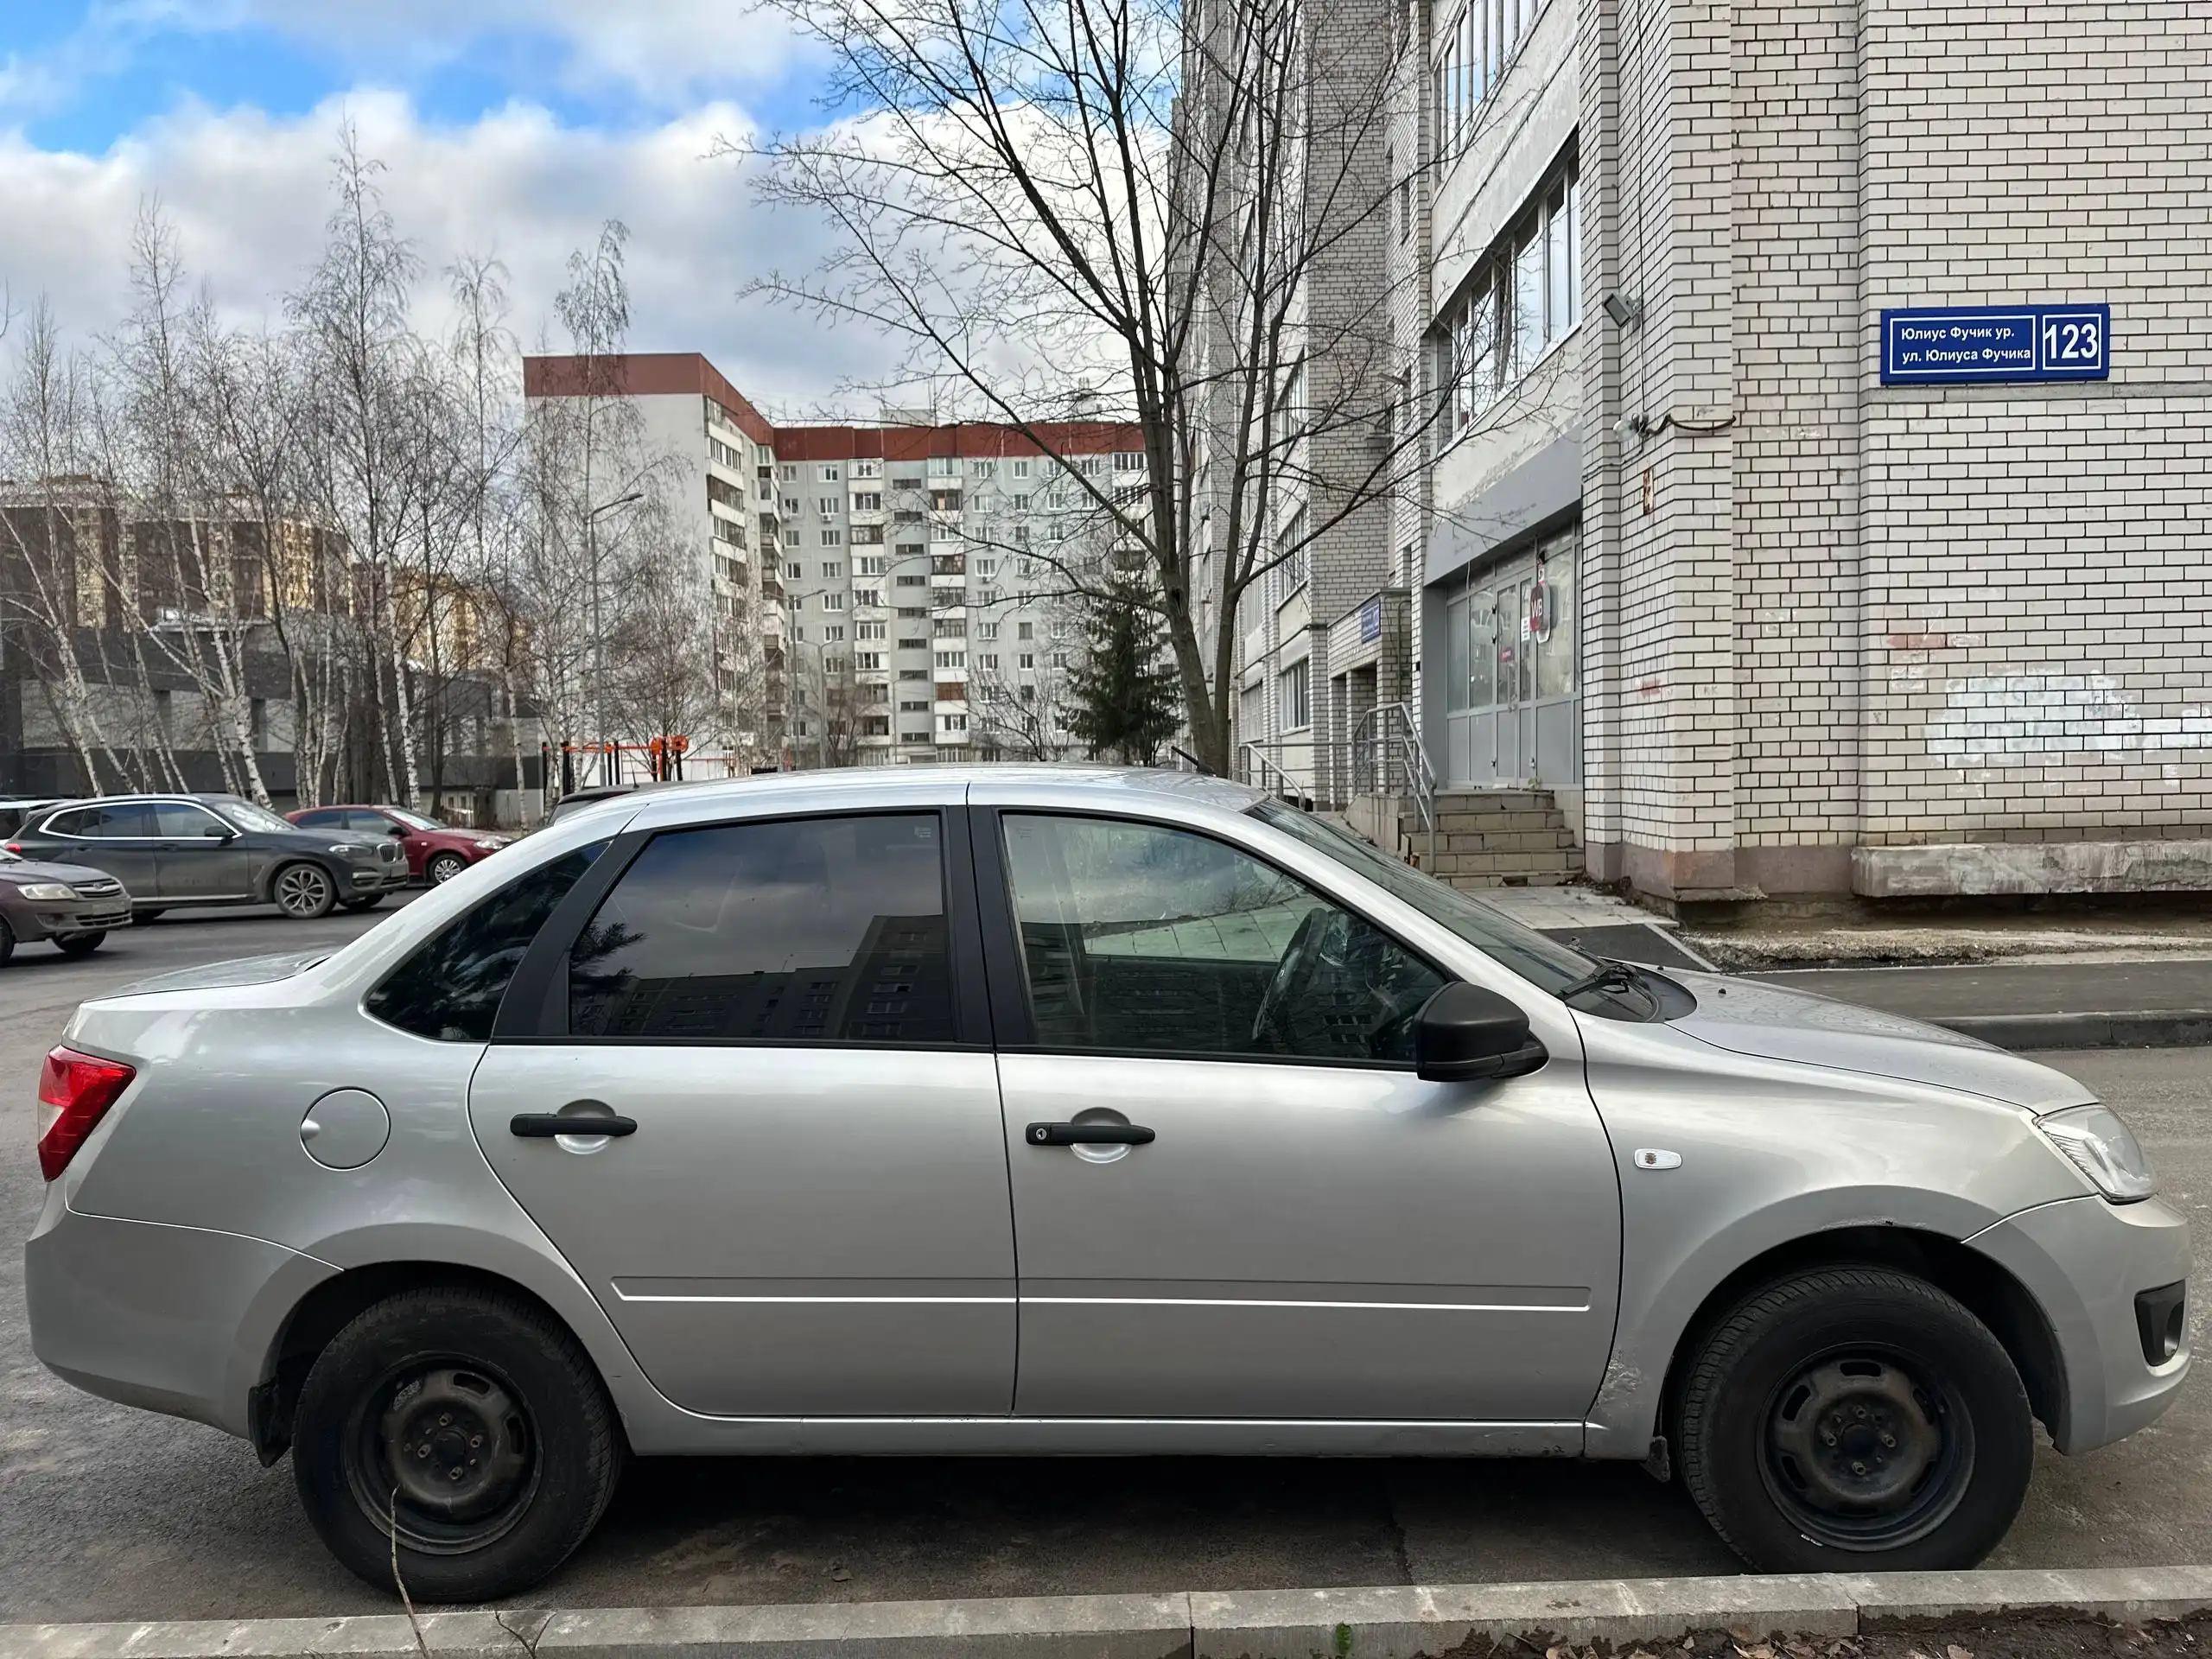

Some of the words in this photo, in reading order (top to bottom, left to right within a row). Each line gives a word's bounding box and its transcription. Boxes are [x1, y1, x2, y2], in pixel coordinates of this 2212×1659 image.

[1901, 327, 1946, 341] Юлиус
[1950, 326, 1993, 342] Фучик
[1995, 327, 2014, 341] ур.
[2044, 323, 2098, 359] 123
[1902, 351, 1922, 365] ул.
[1925, 349, 1978, 364] Юлиуса
[1982, 347, 2031, 363] Фучика
[1531, 599, 1543, 618] WB
